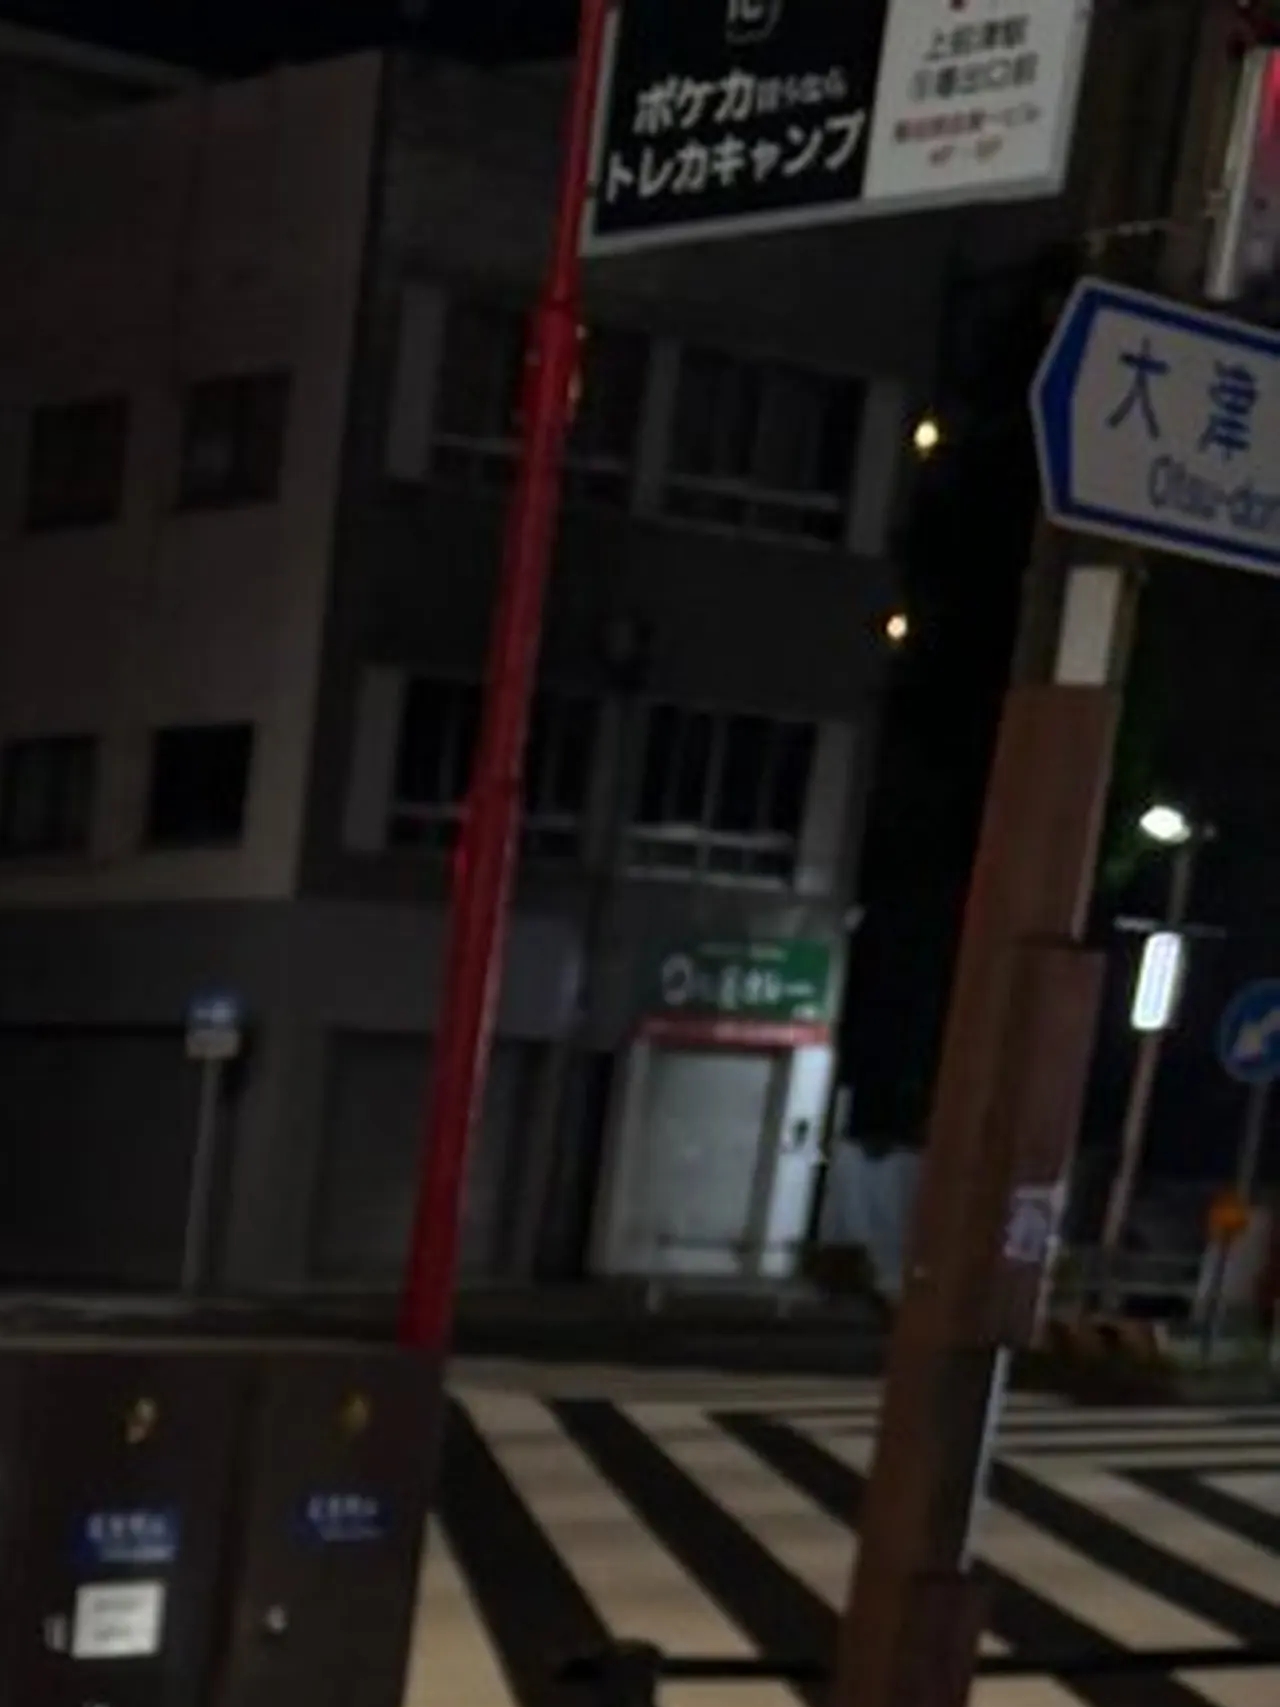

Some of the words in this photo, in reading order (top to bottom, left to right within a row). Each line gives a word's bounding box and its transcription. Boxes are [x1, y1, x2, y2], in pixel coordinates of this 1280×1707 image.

[604, 109, 866, 205] トレカキャンプ
